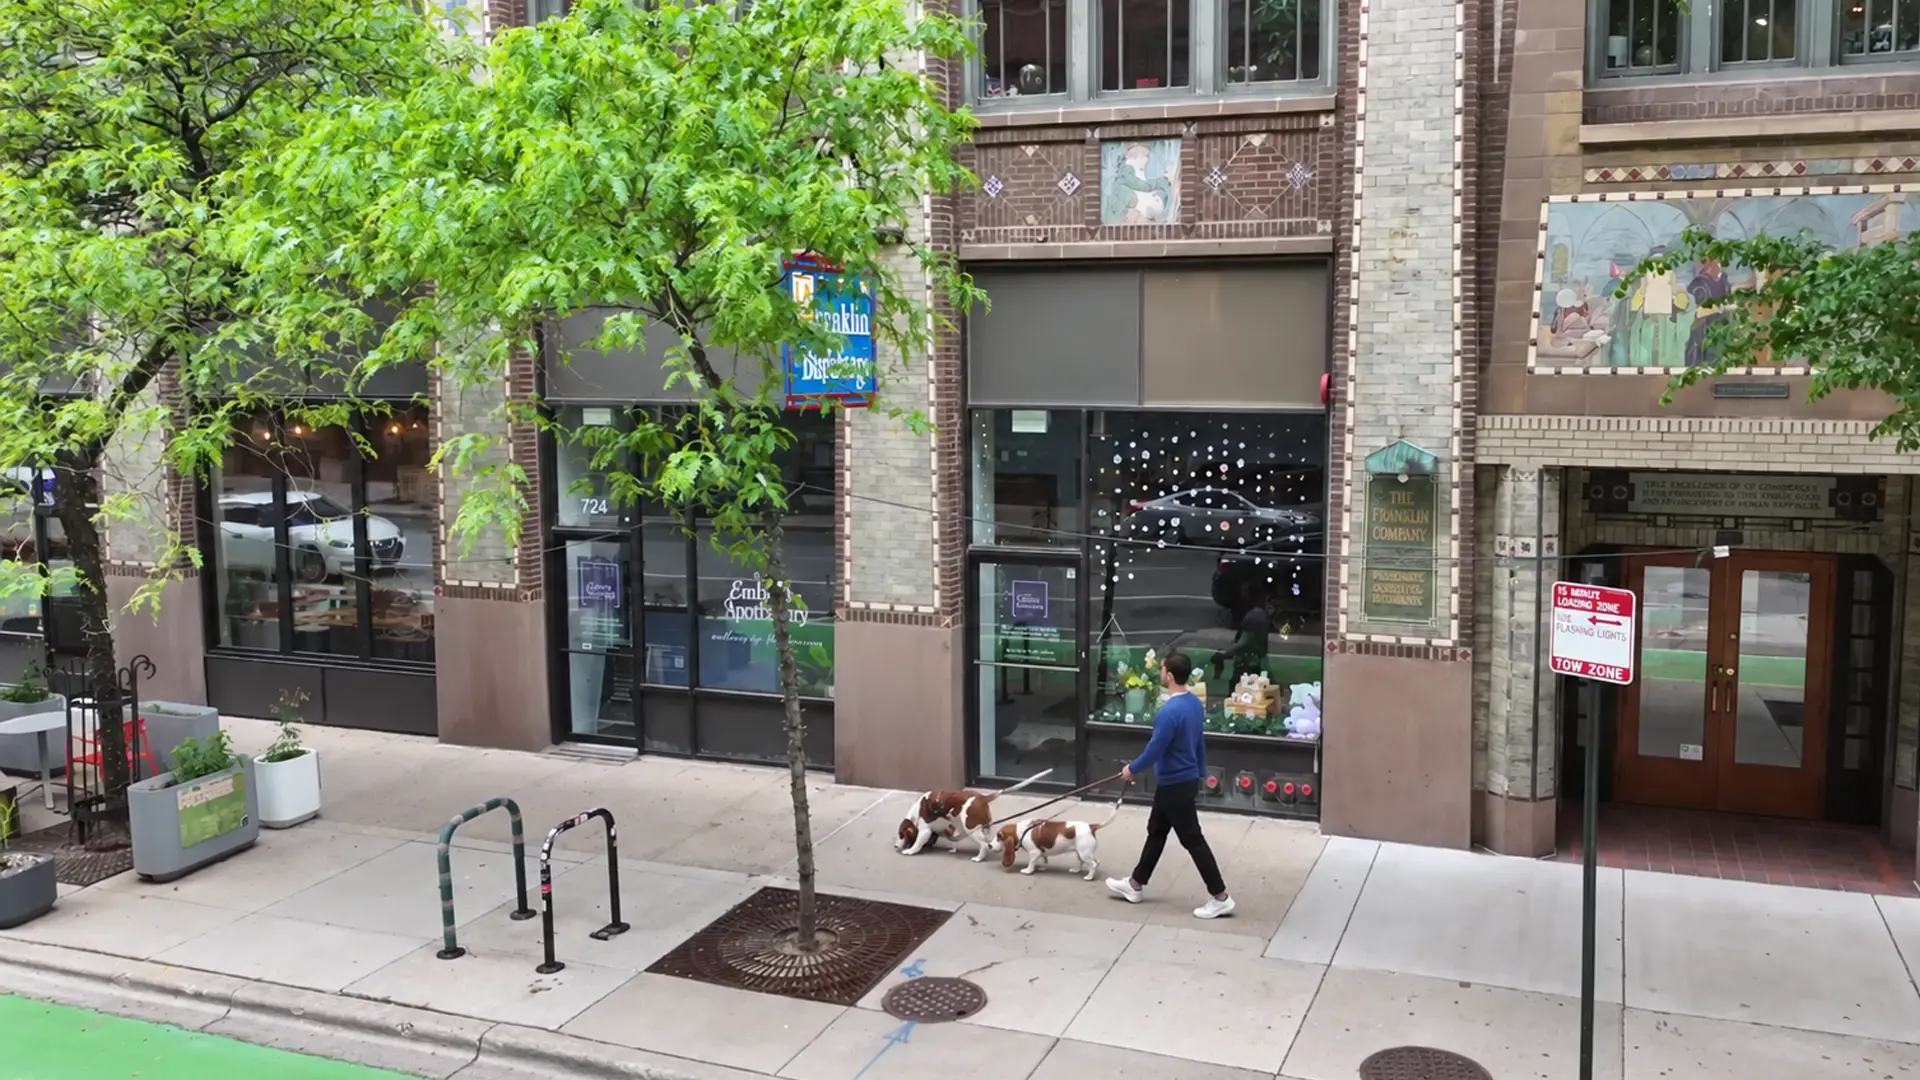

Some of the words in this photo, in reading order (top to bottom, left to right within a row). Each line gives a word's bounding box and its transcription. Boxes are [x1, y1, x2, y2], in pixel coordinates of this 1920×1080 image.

[1390, 491, 1414, 504] THE
[581, 498, 608, 514] 724
[1372, 508, 1428, 523] FRANKLIN
[1373, 527, 1427, 541] COMPANY
[724, 597, 809, 627] Apothary
[1557, 598, 1593, 610] LOADING
[1596, 601, 1620, 614] ZONE
[1556, 623, 1595, 638] FLASHING
[1597, 629, 1627, 642] LIGHTS
[1555, 658, 1583, 673] TOW
[1588, 663, 1624, 680] ZONE
